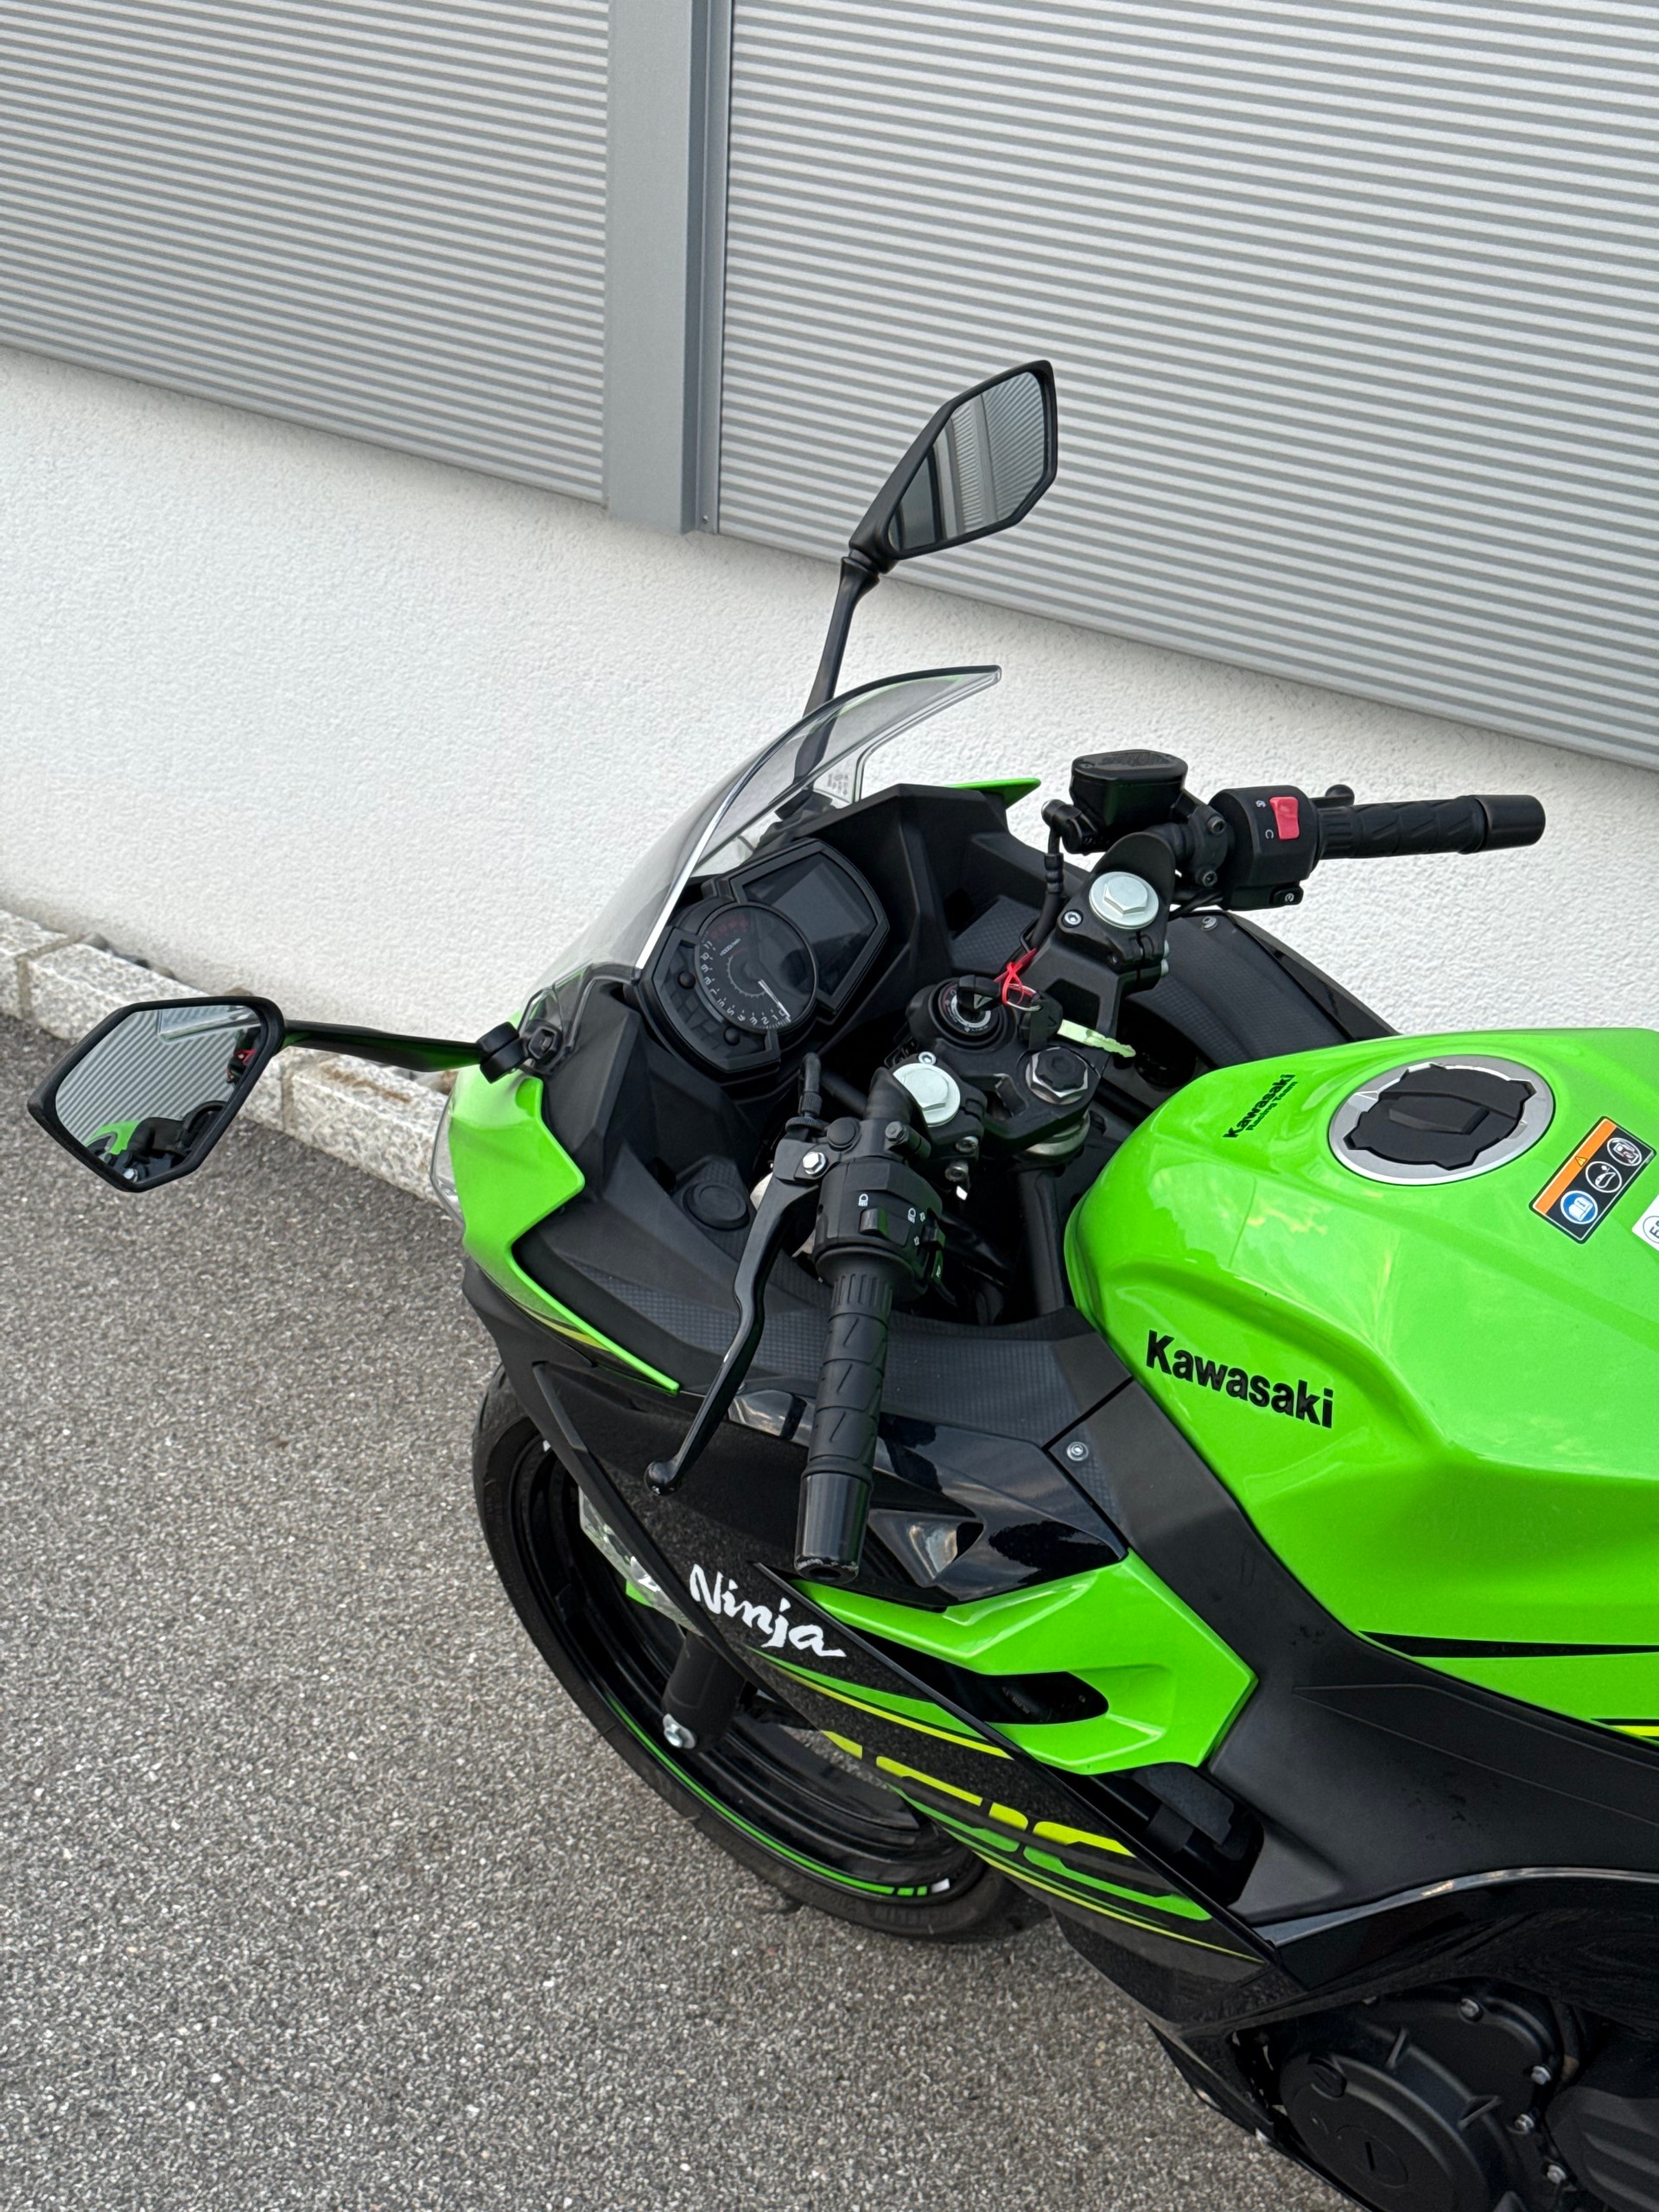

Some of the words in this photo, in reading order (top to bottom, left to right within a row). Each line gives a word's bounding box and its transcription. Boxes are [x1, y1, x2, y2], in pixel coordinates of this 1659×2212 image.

[1222, 1074, 1296, 1138] Kawasaki
[1245, 1103, 1278, 1130] Racing
[1272, 1081, 1299, 1102] Team
[1146, 1329, 1334, 1428] Kawasaki
[689, 1563, 847, 1658] Ninja
